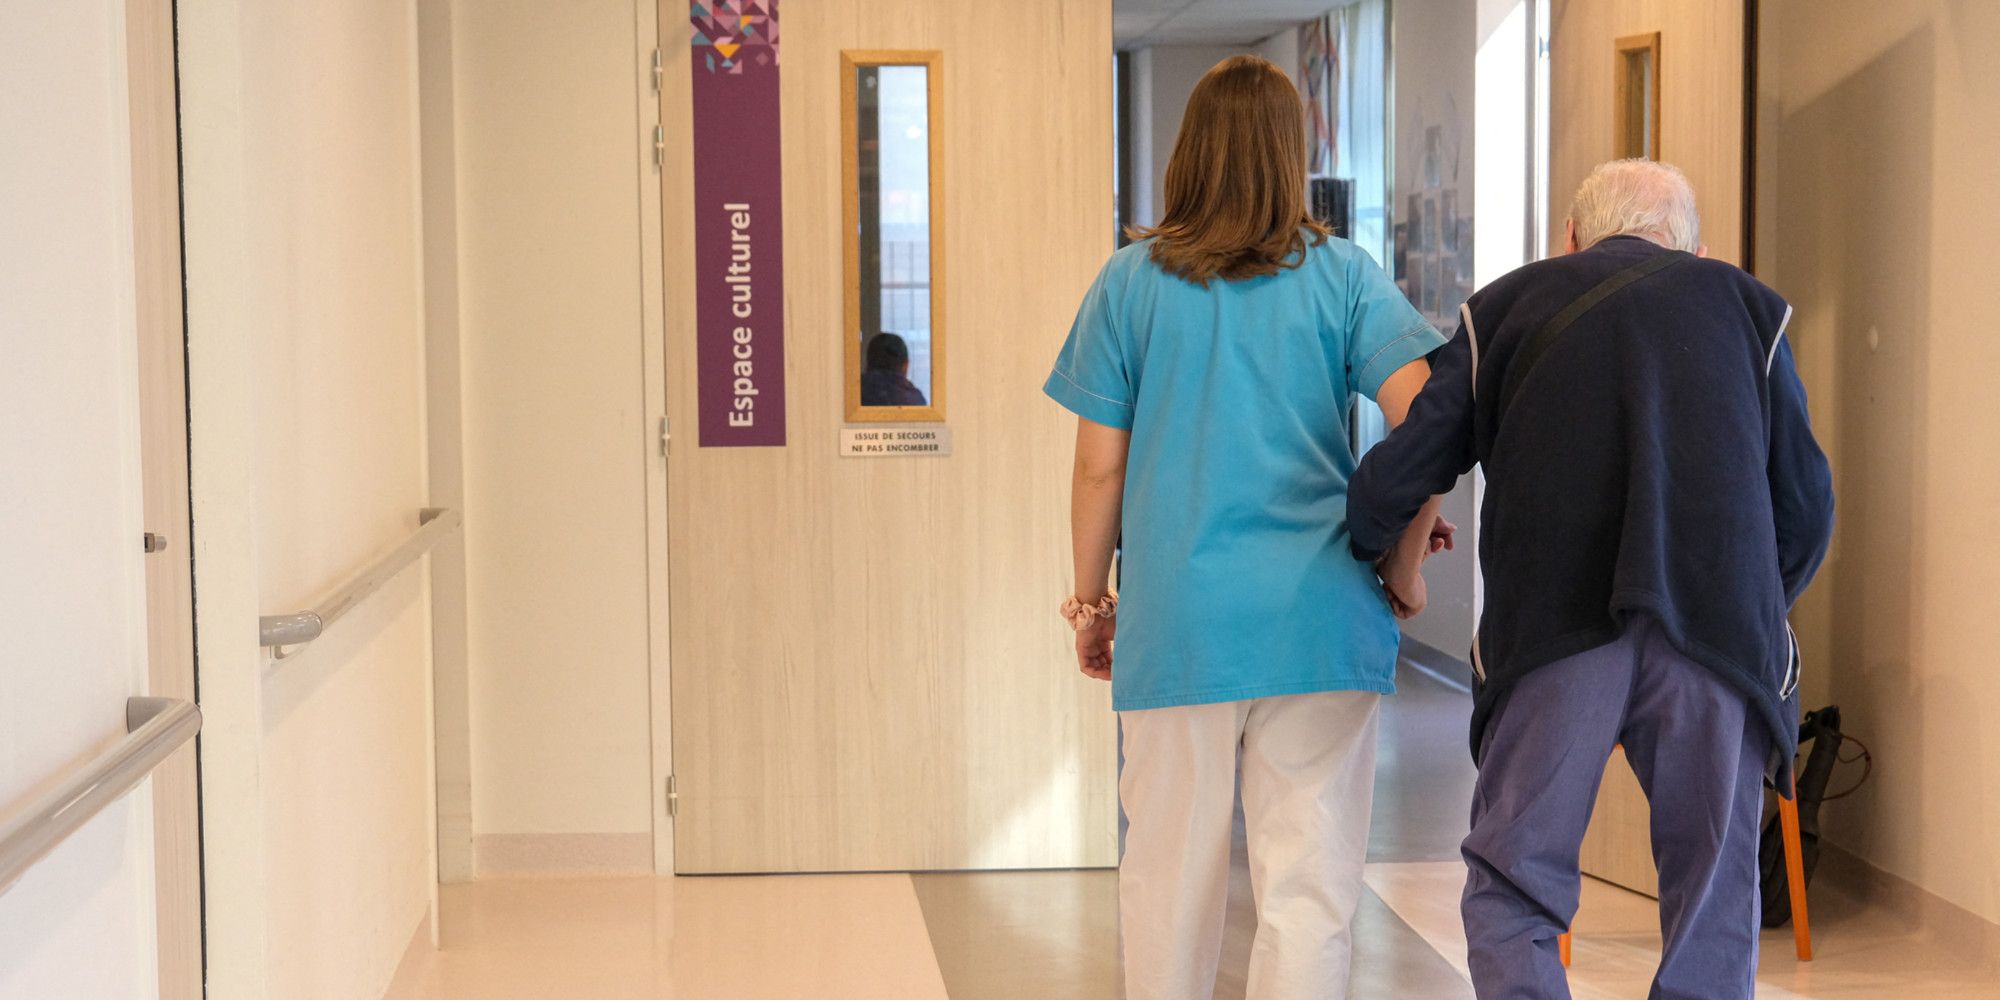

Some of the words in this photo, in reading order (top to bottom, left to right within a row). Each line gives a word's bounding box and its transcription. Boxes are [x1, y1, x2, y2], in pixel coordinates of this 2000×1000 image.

[724, 203, 752, 318] culturel
[729, 327, 759, 427] Espace
[852, 444, 863, 452] NE
[867, 444, 883, 452] PAS
[886, 444, 939, 452] ENCOMBRER
[855, 432, 878, 440] ISSUE
[882, 432, 893, 440] DE
[897, 432, 936, 440] SECOURS
